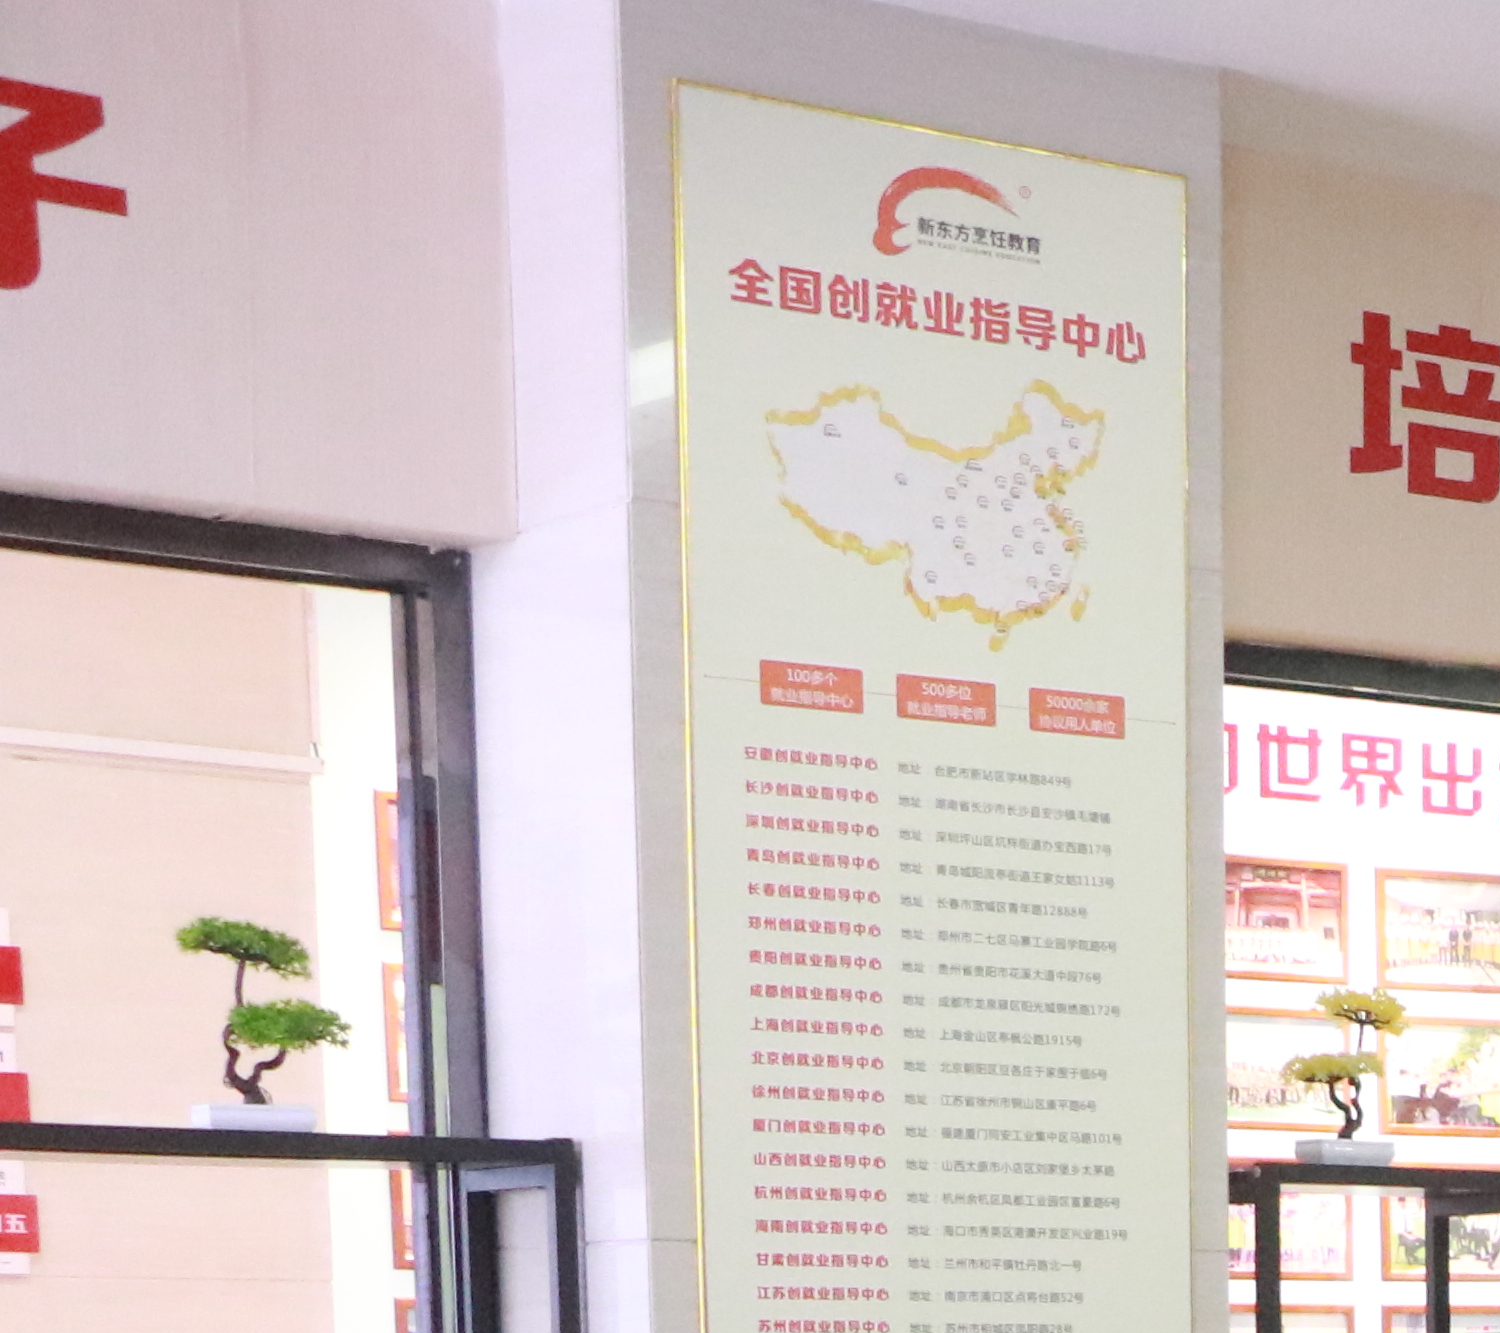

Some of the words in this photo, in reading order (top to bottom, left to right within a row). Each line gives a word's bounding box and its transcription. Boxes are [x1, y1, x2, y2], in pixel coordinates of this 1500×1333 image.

[917, 216, 1041, 254] 新东方烹饪教育
[728, 258, 1147, 364] 全国创就业指导中心
[786, 668, 838, 686] 100多个
[921, 682, 972, 702] 500多位
[0, 1213, 29, 1234] 五
